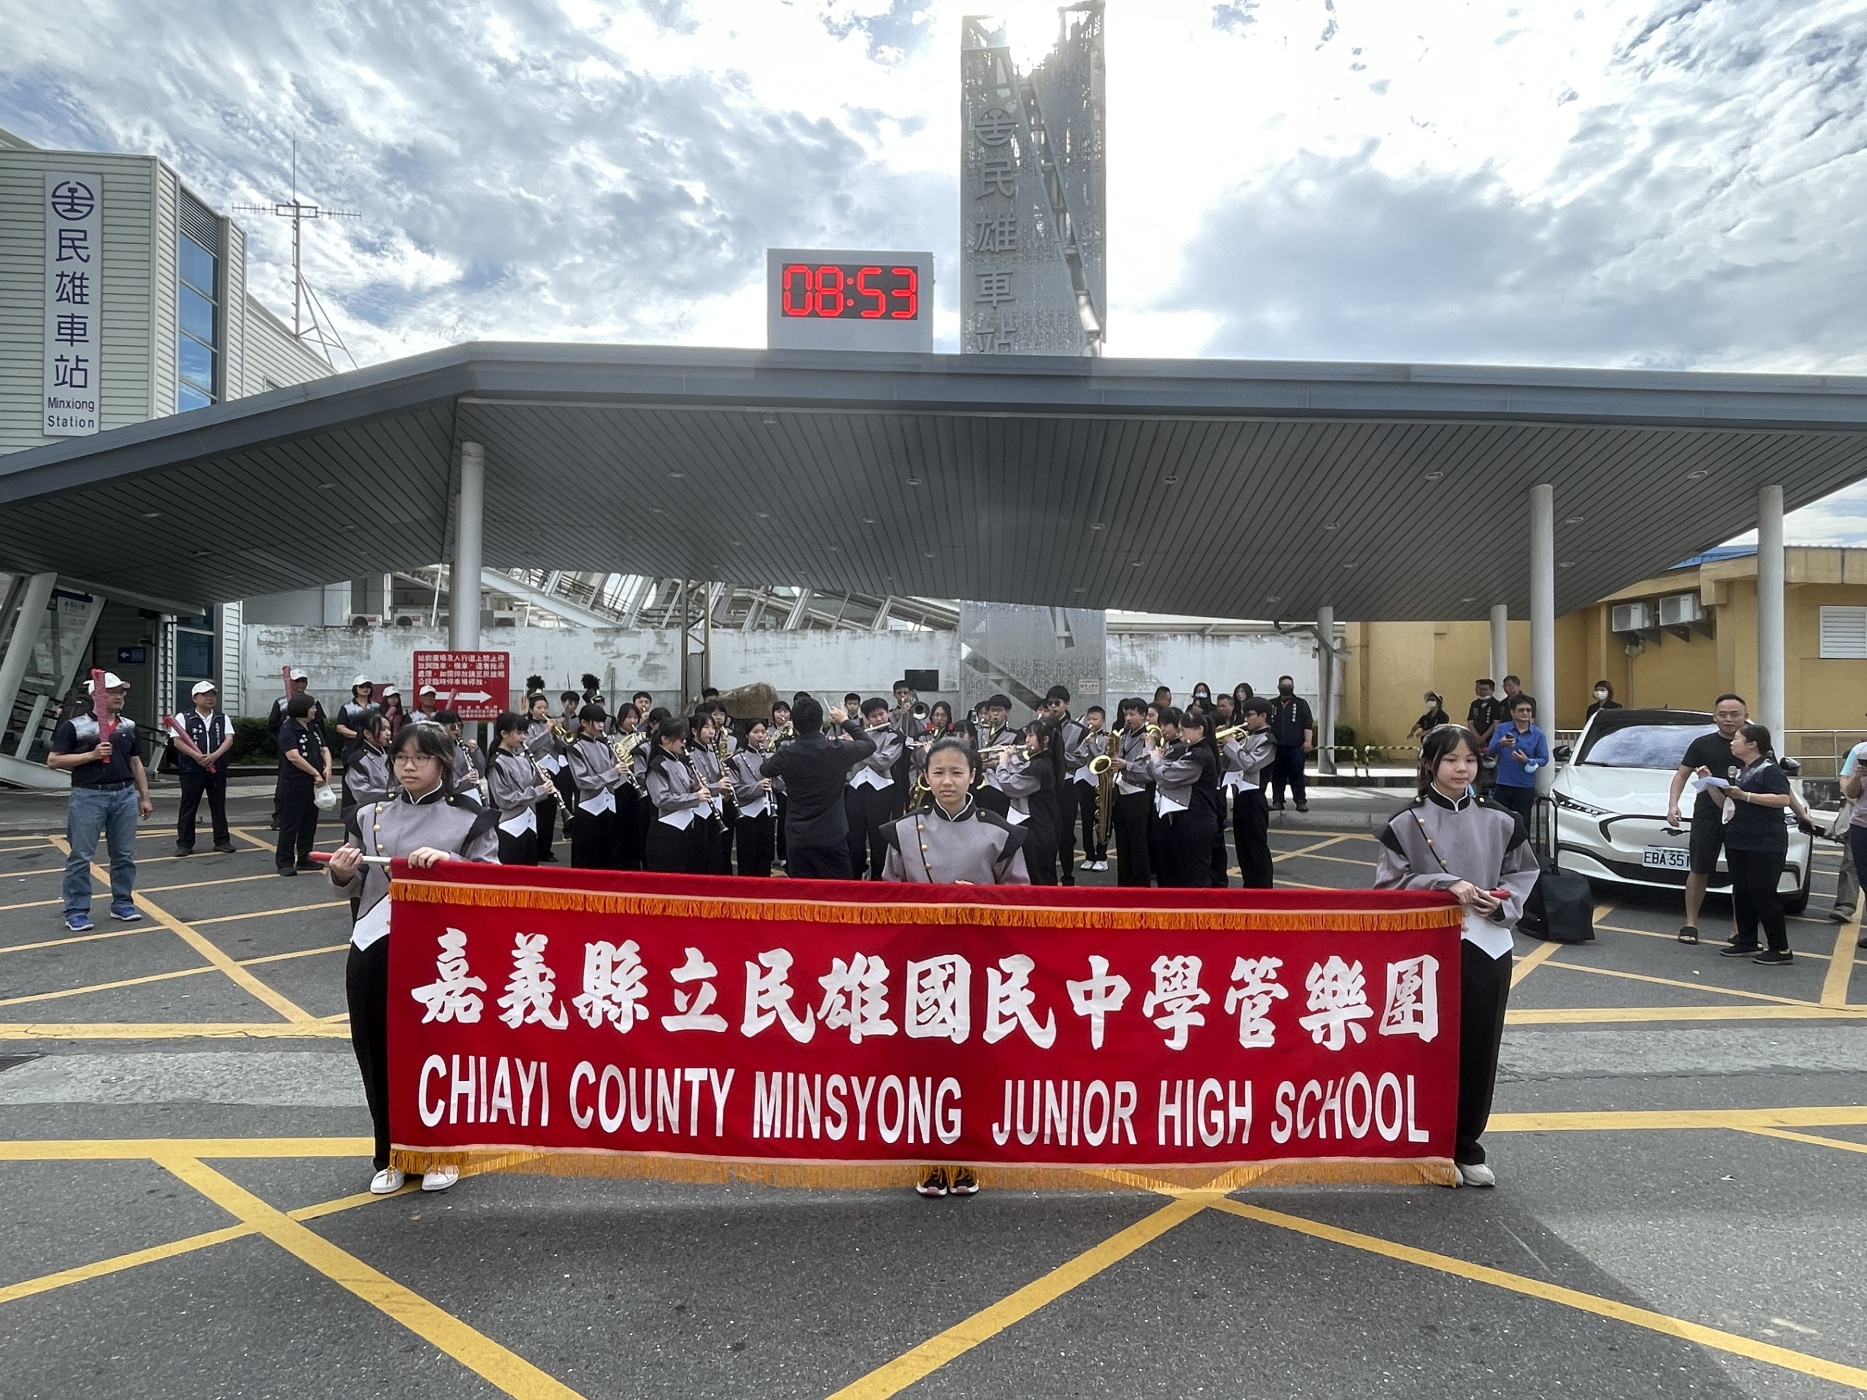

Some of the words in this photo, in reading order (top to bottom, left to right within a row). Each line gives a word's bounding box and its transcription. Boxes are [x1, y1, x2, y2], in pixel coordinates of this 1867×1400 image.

[783, 265, 917, 319] 08:53
[974, 158, 1018, 356] 民雄車站
[54, 228, 91, 389] 民雄車站
[47, 396, 95, 413] Minxiong
[47, 414, 95, 428] Station
[411, 927, 1440, 1051] 嘉義縣立民雄國民中學管樂團
[419, 1054, 549, 1128] CHIAYI
[569, 1061, 735, 1137] COUNTY
[753, 1072, 962, 1146] MINSYONG
[992, 1079, 1138, 1147] JUNIOR
[1158, 1078, 1253, 1147] HIGH
[1271, 1072, 1430, 1144] SCHOOL
